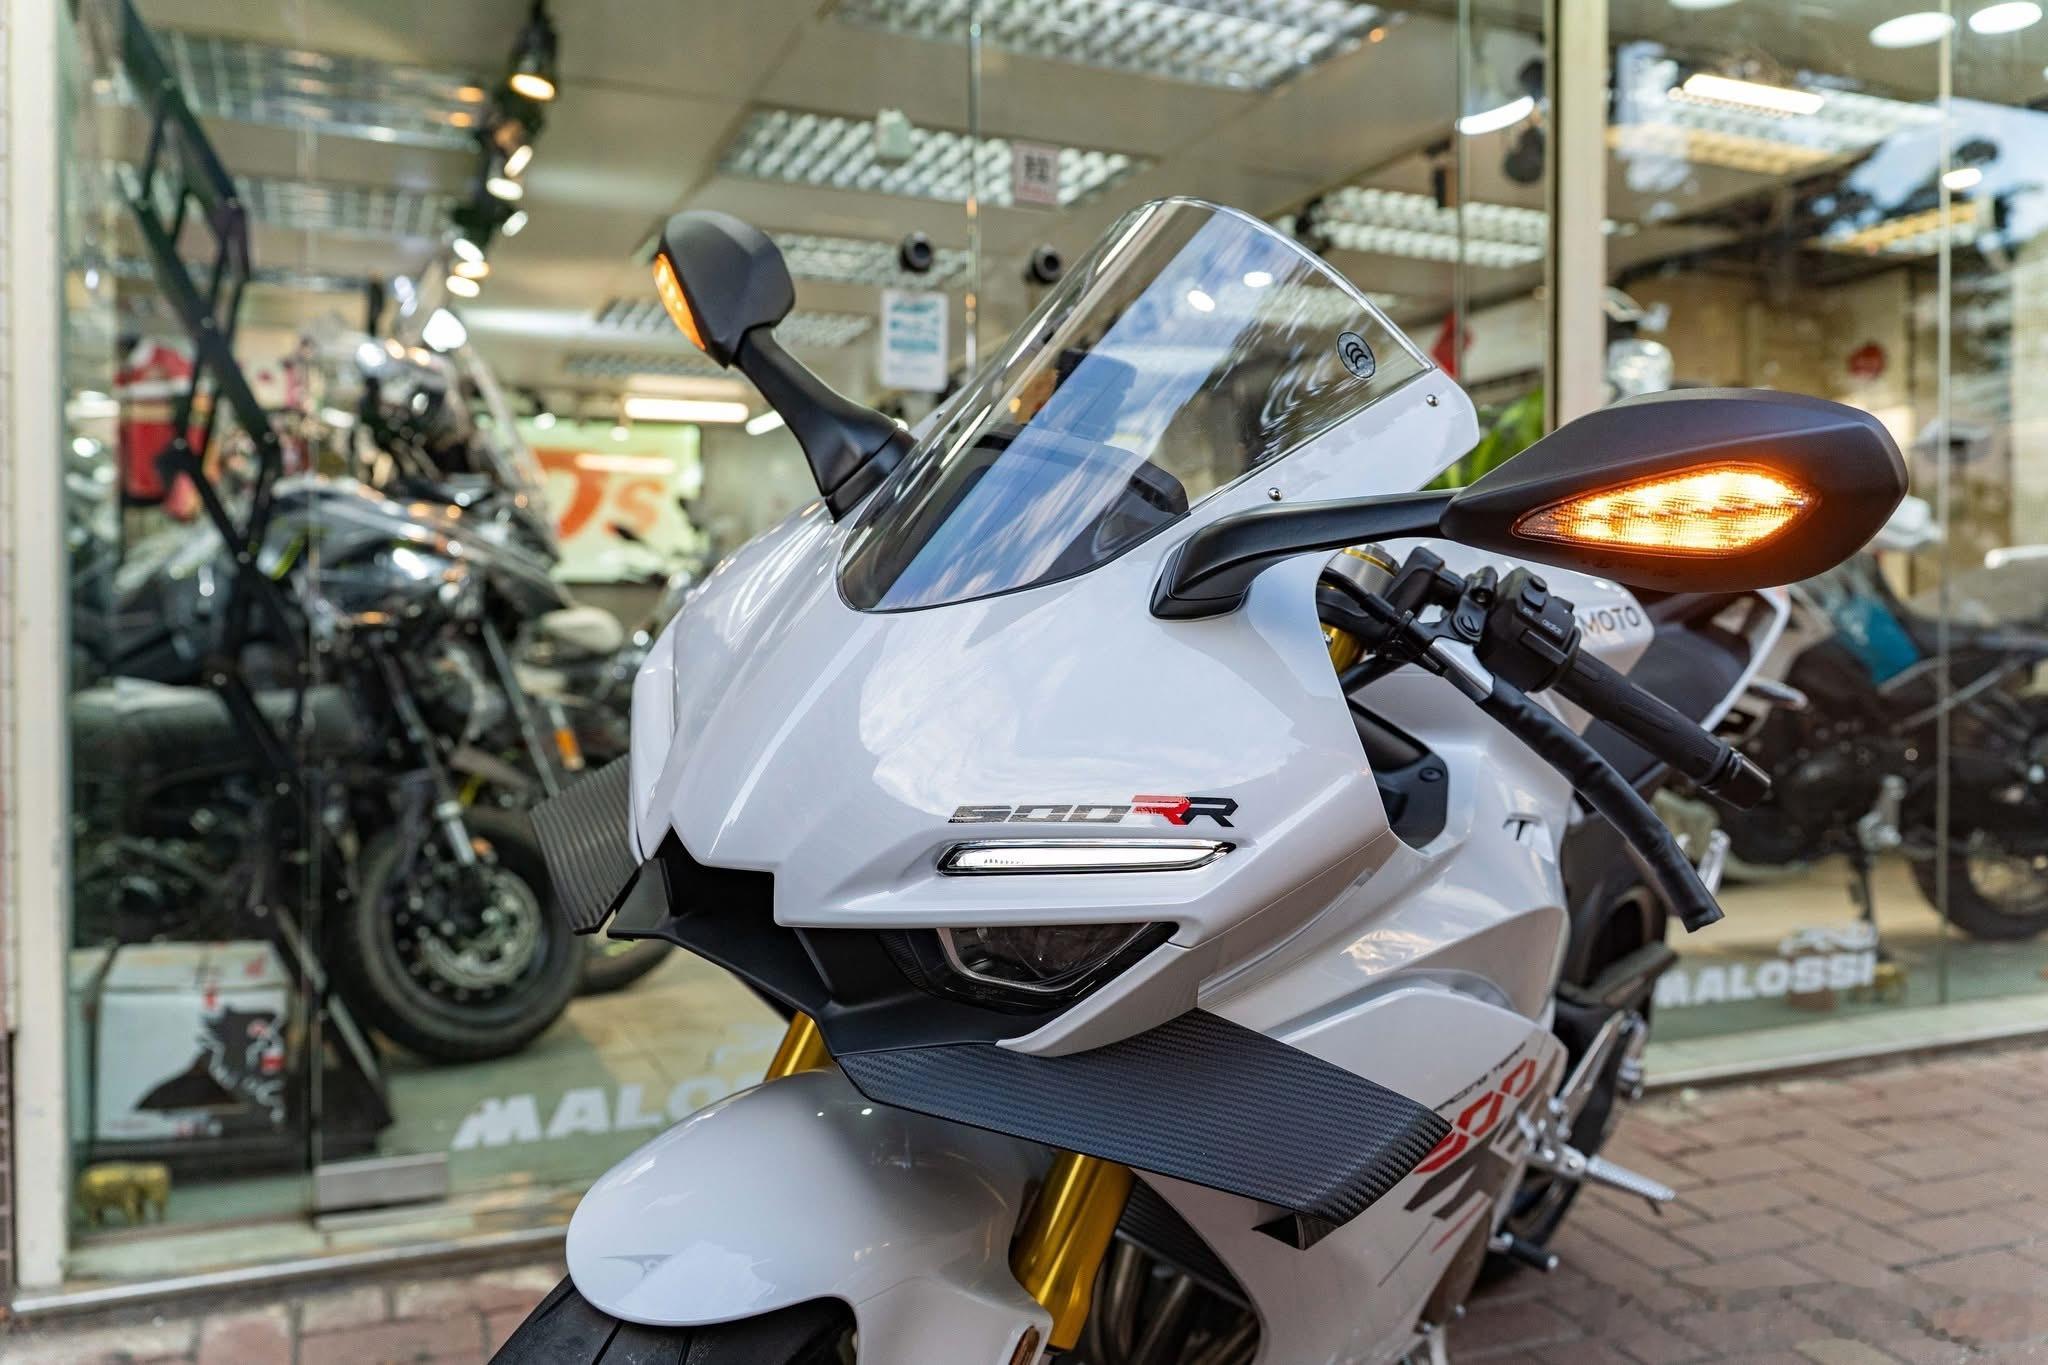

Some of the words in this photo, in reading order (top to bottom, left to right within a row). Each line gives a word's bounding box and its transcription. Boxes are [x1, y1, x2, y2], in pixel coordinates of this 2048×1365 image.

[1577, 605, 1642, 637] MOTO
[1652, 951, 1877, 1008] MALOSSI
[452, 1069, 764, 1151] MALO
